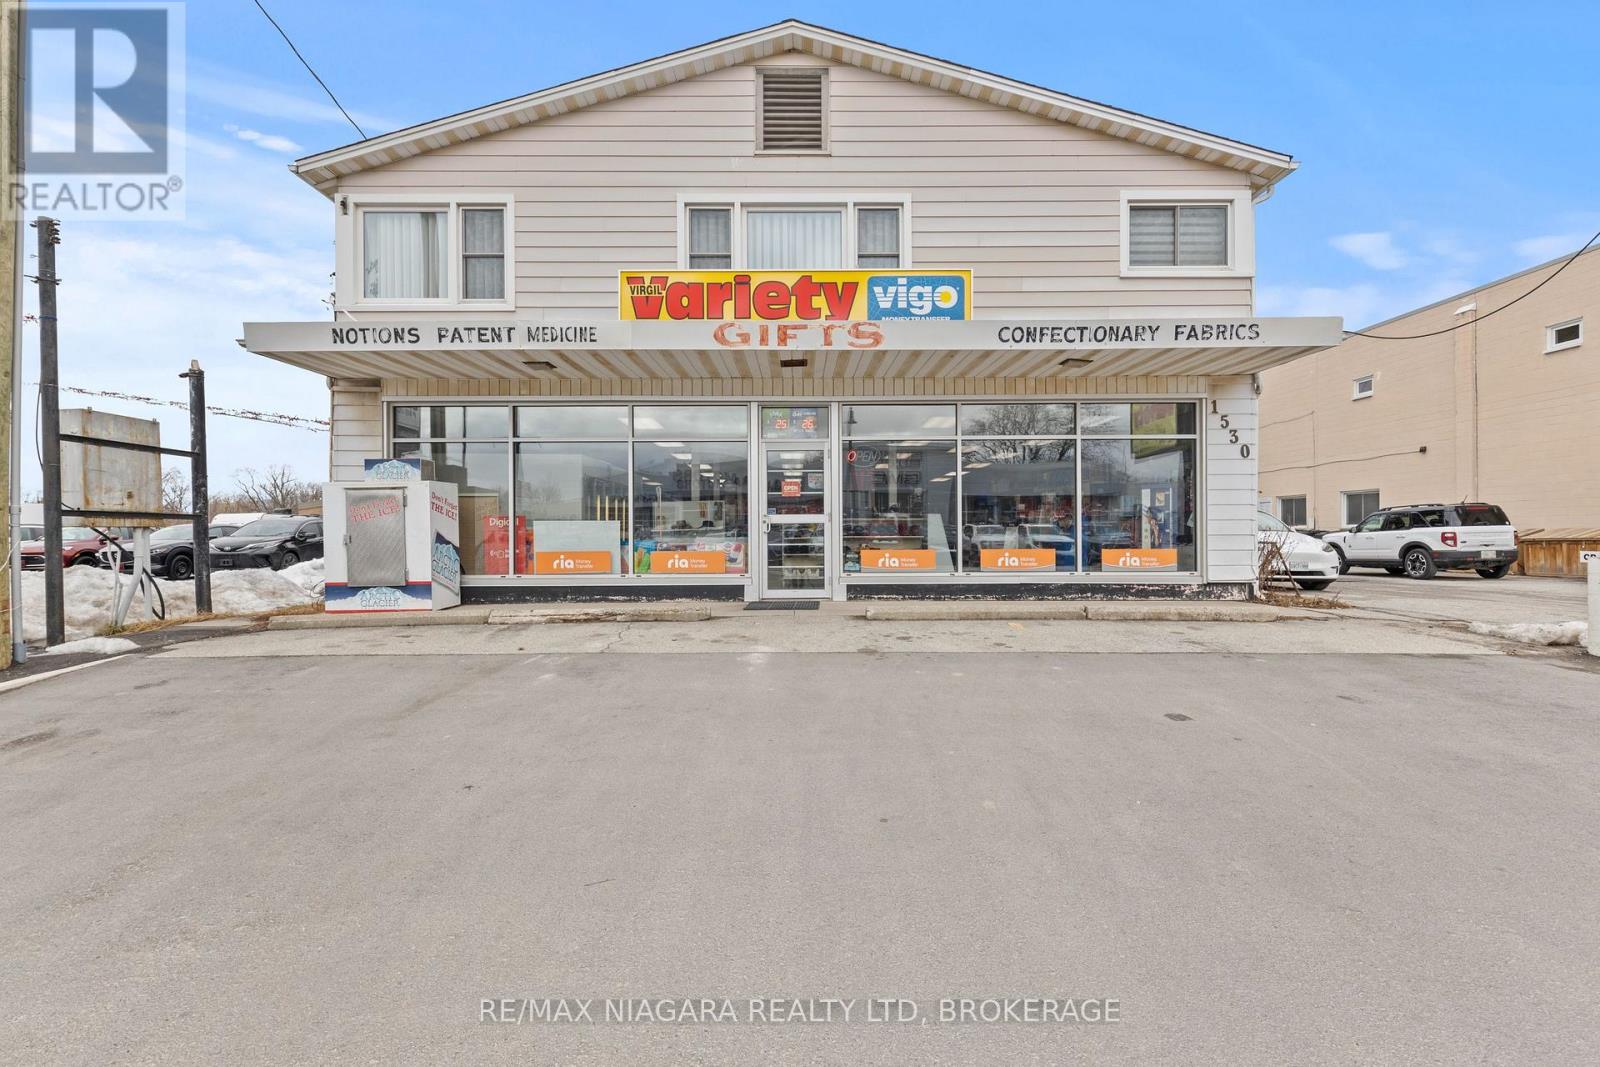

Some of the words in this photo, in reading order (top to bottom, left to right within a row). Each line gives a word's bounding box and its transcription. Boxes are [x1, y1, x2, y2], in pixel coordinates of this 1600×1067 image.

[630, 285, 662, 295] VIRGIL
[873, 277, 958, 315] vigo
[332, 327, 420, 345] NOTIONS
[437, 327, 515, 344] PATENT
[527, 326, 598, 343] MEDICINE
[713, 321, 885, 349] GIFTS
[998, 325, 1161, 343] CONFECTIONARY
[1174, 323, 1260, 341] FABRICS
[775, 419, 787, 429] 25
[553, 554, 574, 569] ria
[667, 554, 689, 569] ria
[878, 552, 899, 567] ria
[998, 552, 1019, 567] ria
[1119, 552, 1140, 567] ria
